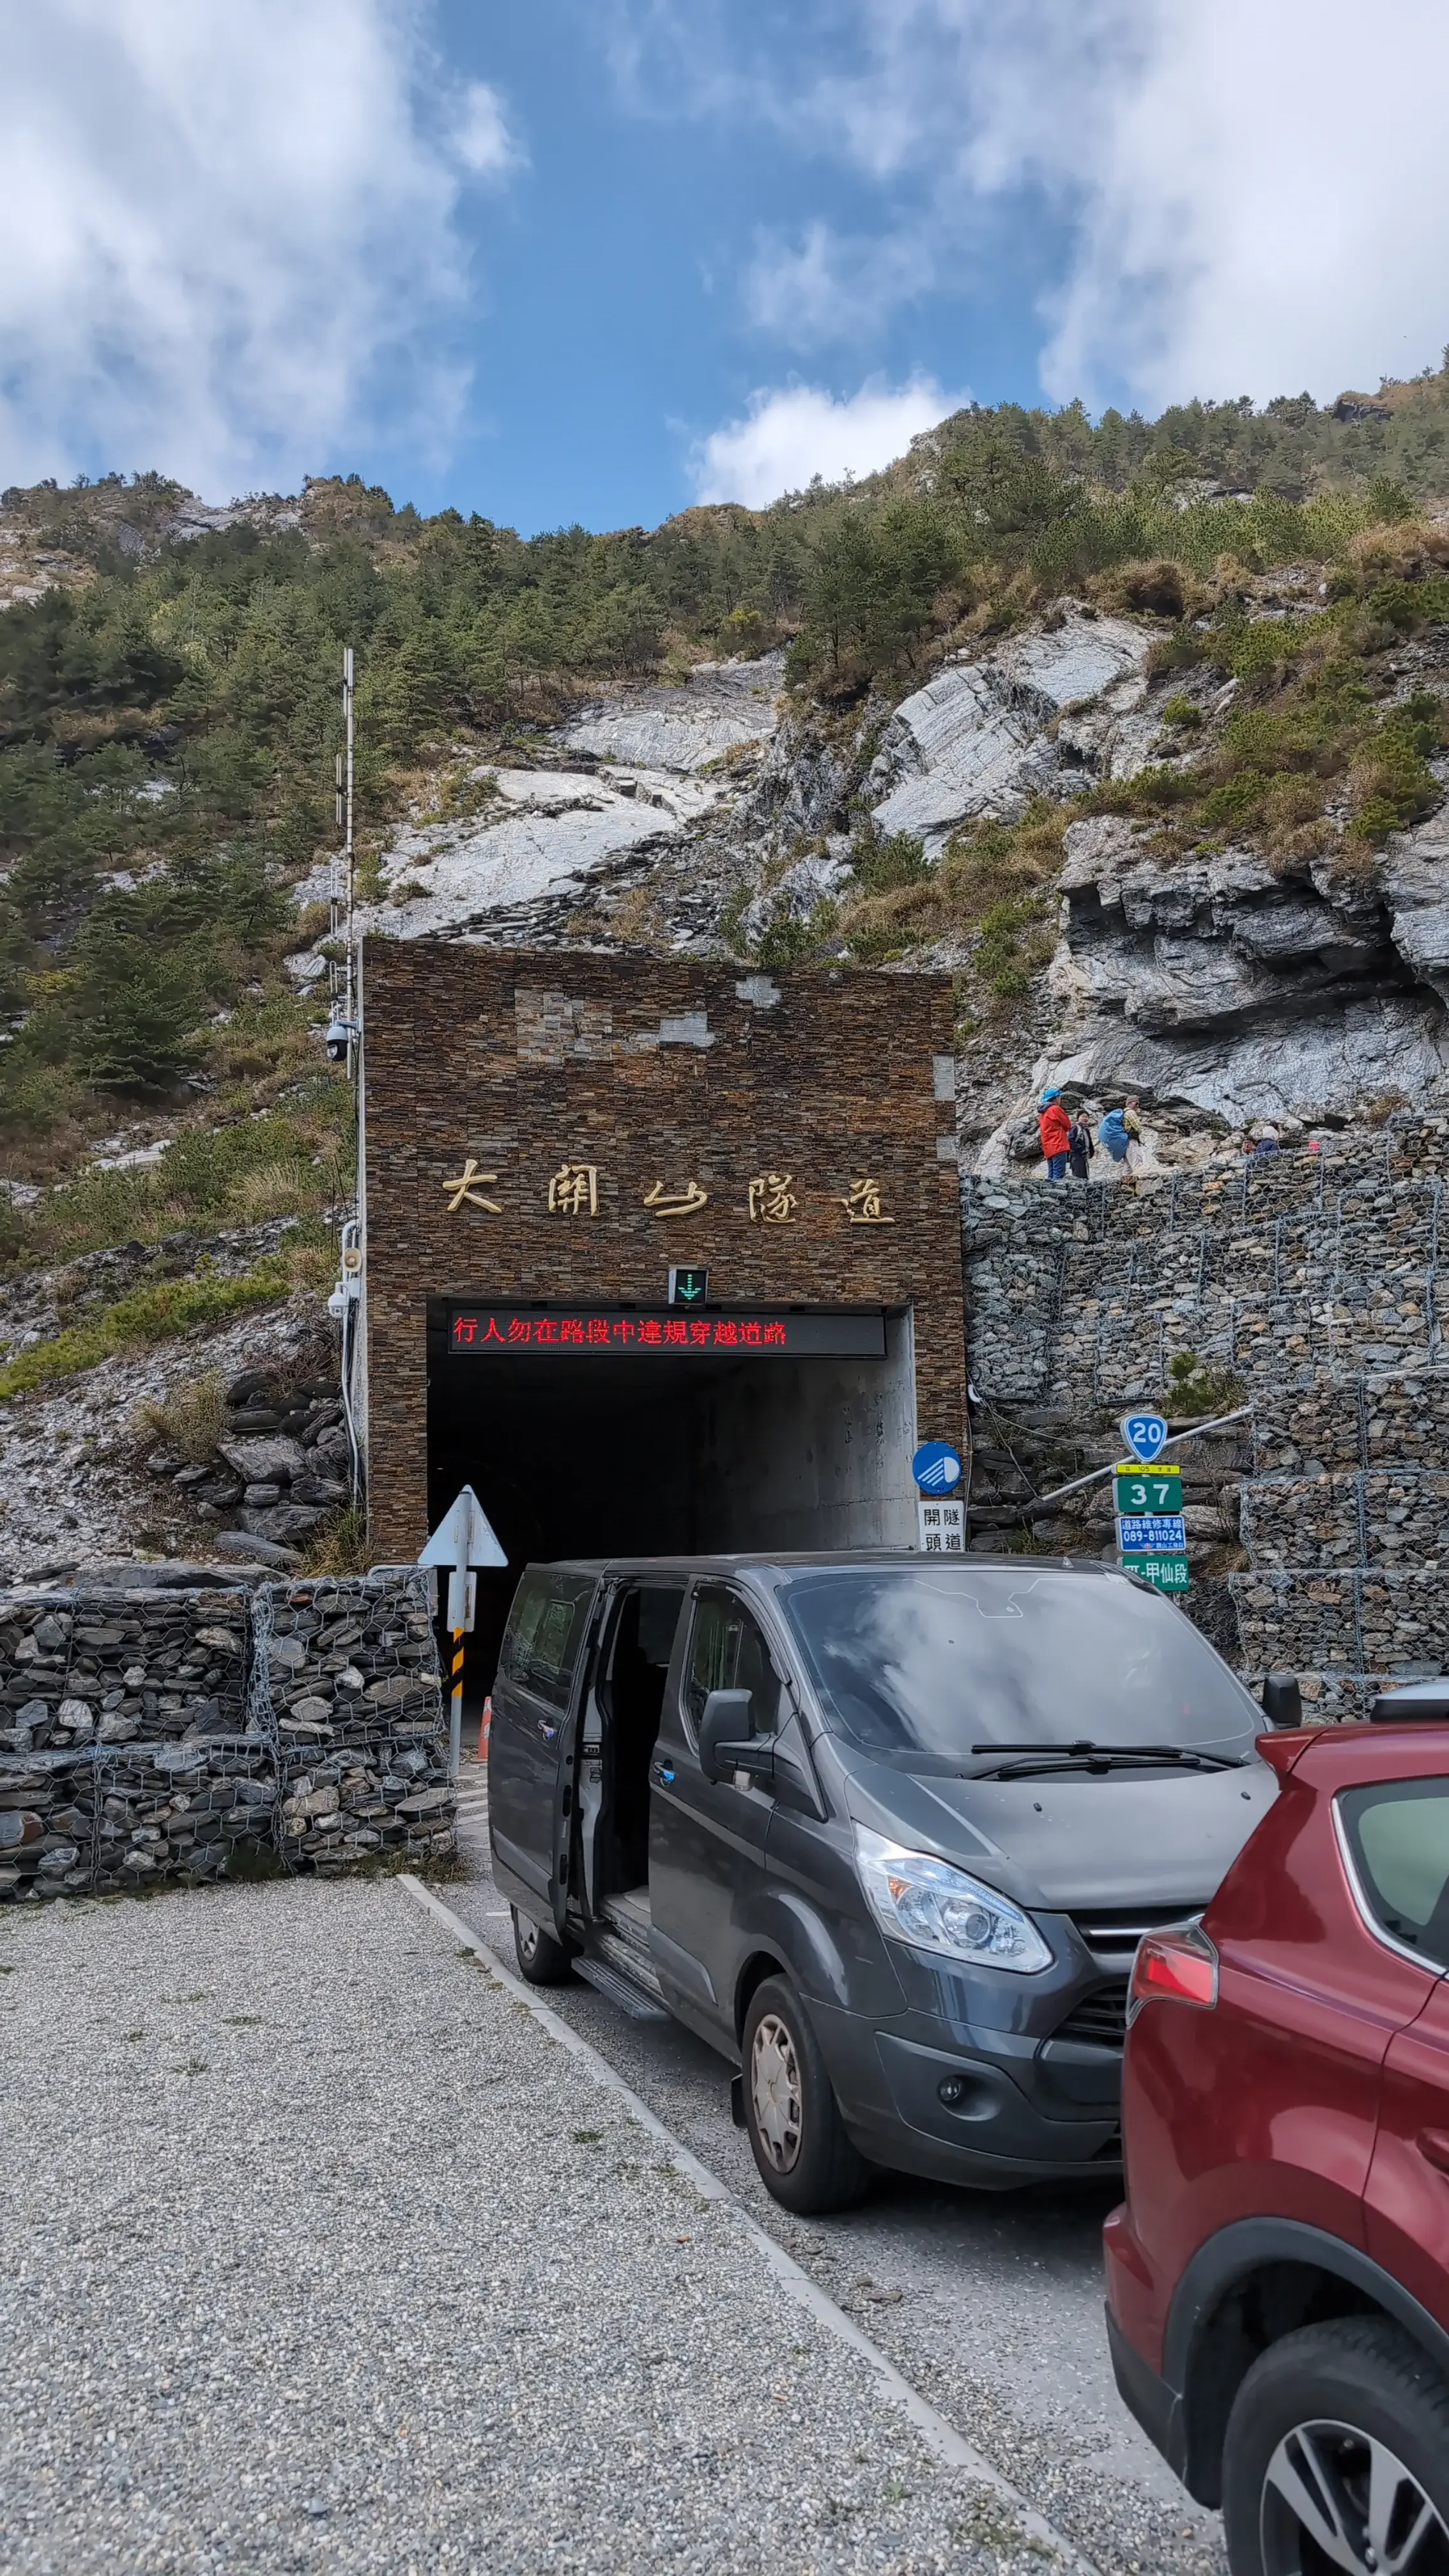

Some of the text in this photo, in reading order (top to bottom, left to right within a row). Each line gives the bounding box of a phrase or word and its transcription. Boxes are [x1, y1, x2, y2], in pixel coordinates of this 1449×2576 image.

[442, 1158, 895, 1223] 大關山隧道
[454, 1317, 786, 1345] 行人勿在路段中違規穿越道路
[1133, 1422, 1161, 1443] 20
[1130, 1483, 1169, 1505] 37
[1122, 1519, 1182, 1529] 道路維修專線
[1124, 1529, 1182, 1542] 089-811024
